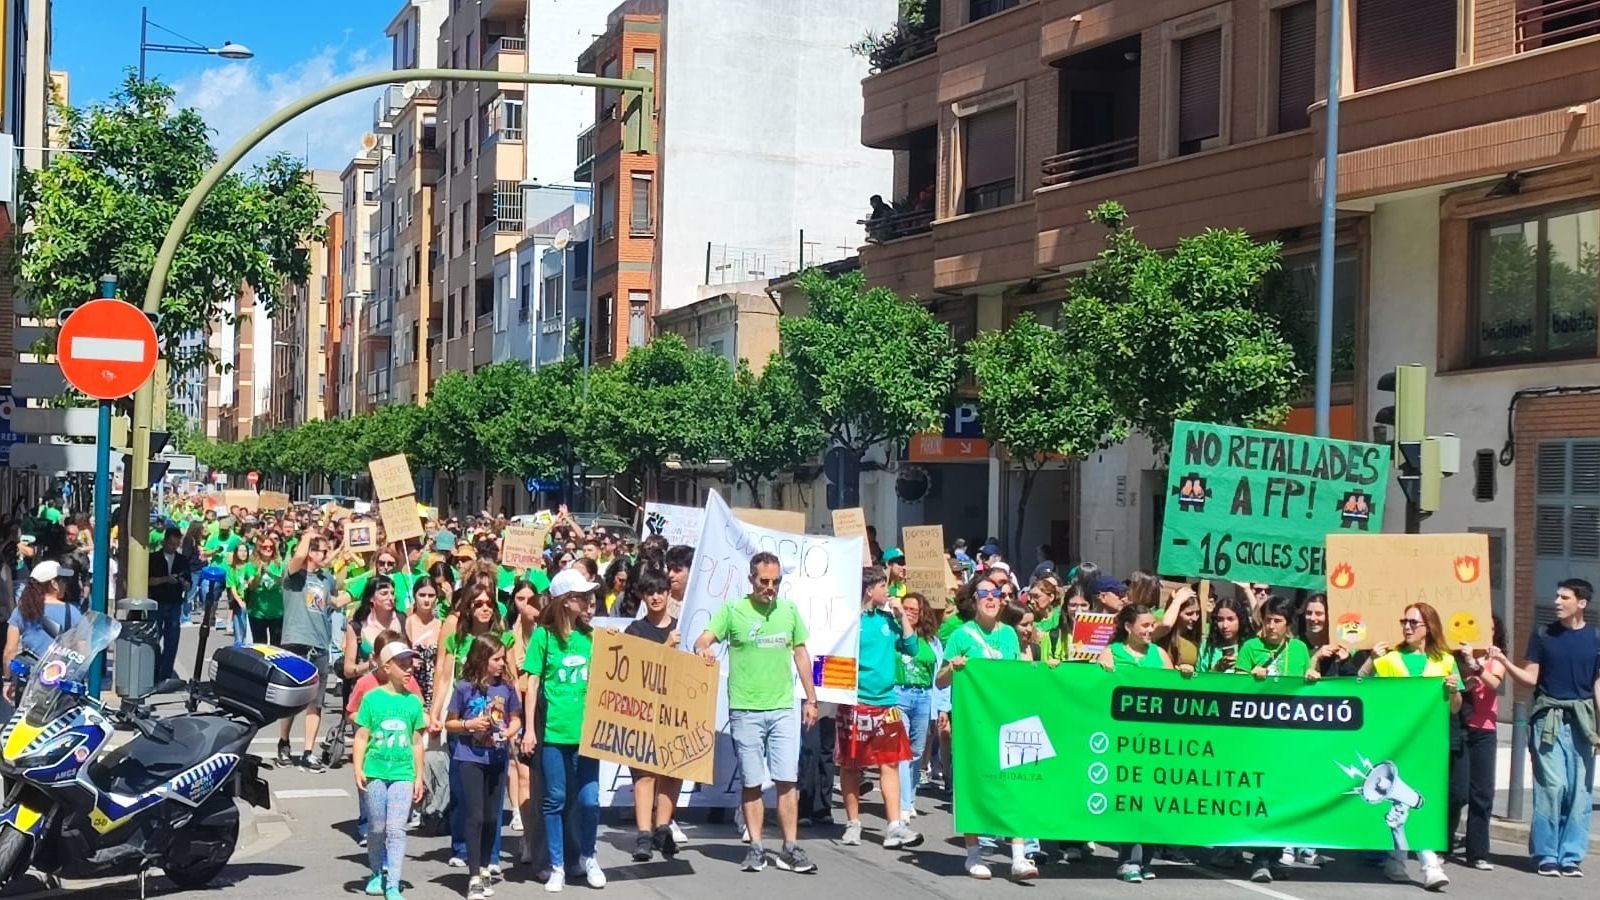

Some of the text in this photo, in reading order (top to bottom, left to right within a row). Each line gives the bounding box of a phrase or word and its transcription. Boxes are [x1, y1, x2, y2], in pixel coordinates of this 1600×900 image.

[955, 403, 977, 433] P
[1185, 430, 1380, 486] NO RETALLADES
[1230, 476, 1317, 519] A FP!
[1199, 532, 1232, 576] 16
[1236, 541, 1292, 569] CICLES
[605, 644, 668, 696] JO VULL
[598, 689, 689, 729] APRENDRE EN LA
[1120, 694, 1353, 723] PER UNA EDUCACIÓ
[590, 719, 659, 767] LLENGUA
[1116, 732, 1216, 758] PÚBLICA
[1116, 765, 1266, 789] DE QUALITAT
[1115, 795, 1269, 818] EN VALENCIÀ
